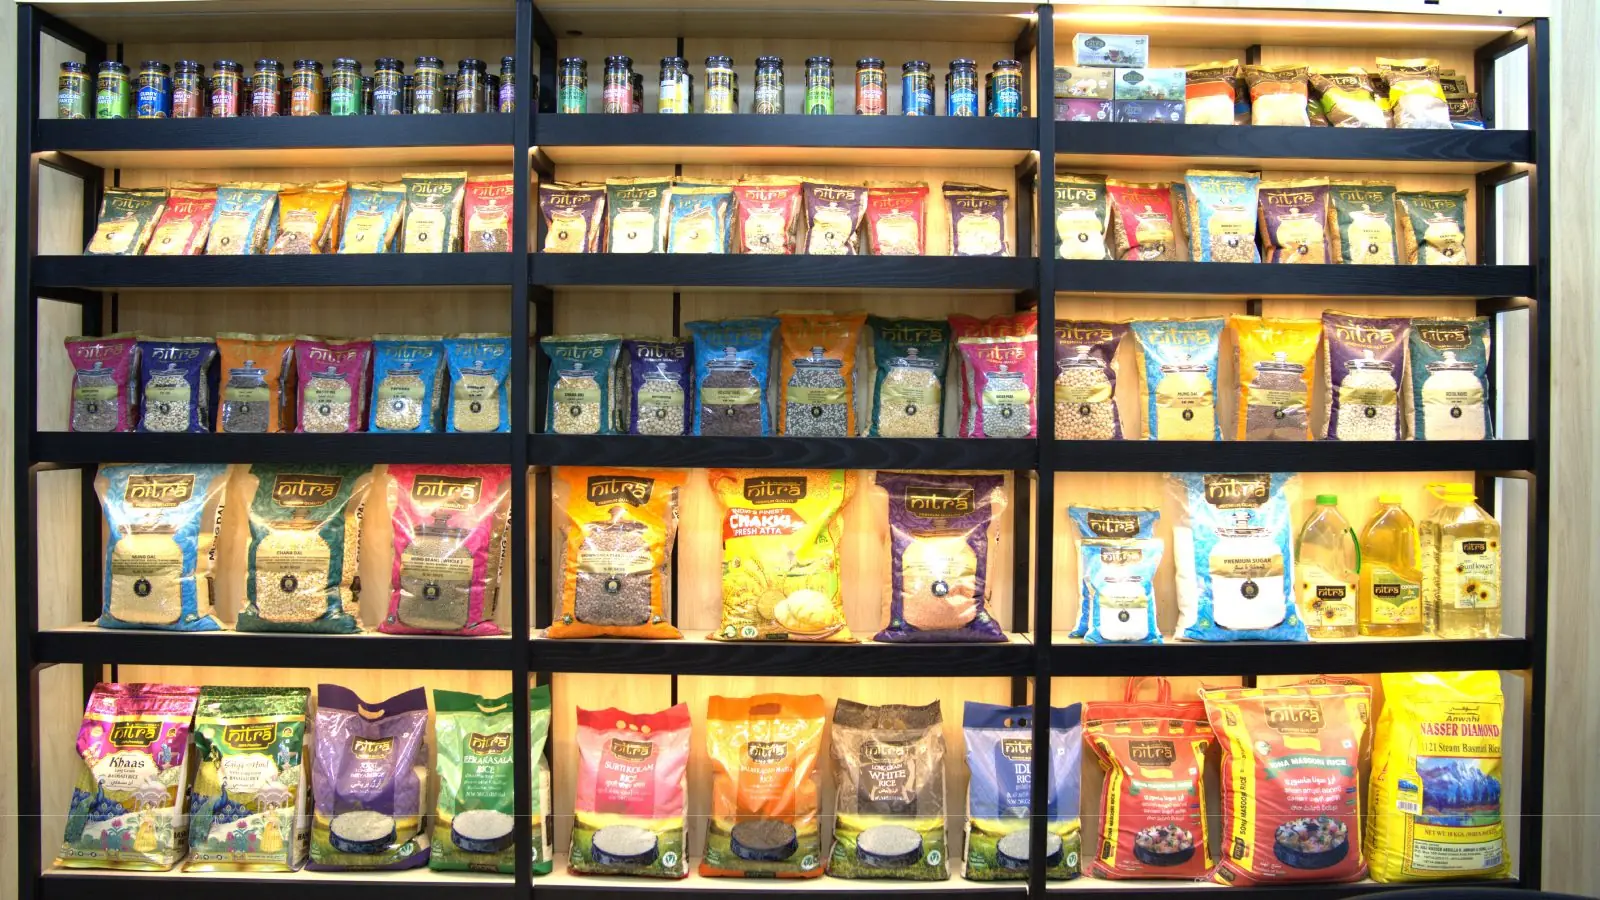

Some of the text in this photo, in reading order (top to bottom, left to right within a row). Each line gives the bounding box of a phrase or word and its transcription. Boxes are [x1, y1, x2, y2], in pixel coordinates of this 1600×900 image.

[411, 179, 452, 196] nitra
[473, 181, 514, 197] nitra
[617, 186, 657, 200] nitra
[745, 186, 787, 200] nitra
[813, 185, 856, 200] nitra
[1340, 187, 1384, 202] nitra
[1267, 189, 1315, 206] nitra
[882, 322, 944, 342] nitra
[1055, 323, 1113, 342] nitra
[1335, 319, 1396, 343] nitra
[1420, 327, 1466, 342] nitra
[152, 346, 201, 361] nitra
[310, 346, 357, 363] nitra
[555, 344, 604, 360] nitra
[637, 341, 685, 359] nitra
[977, 344, 1026, 361] nitra
[131, 479, 189, 499] nitra
[277, 479, 337, 497] nitra
[416, 479, 475, 500] nitra
[591, 478, 648, 500] nitra
[747, 480, 801, 498] nitra
[1208, 478, 1267, 498] nitra
[910, 493, 969, 511] nitra
[729, 513, 792, 530] CHAKKI
[1089, 517, 1136, 534] nitra
[734, 527, 782, 537] FRESH ATTA
[1318, 586, 1345, 598] nitra
[1375, 585, 1400, 596] nitra
[1269, 702, 1320, 723] nitra
[1445, 714, 1481, 723] Anwahi
[114, 722, 157, 740] nitra
[227, 724, 274, 743] nitra
[1420, 722, 1500, 738] NASSER DIAMOND
[612, 741, 650, 756] nitra
[1005, 739, 1032, 755] nitr
[1131, 742, 1173, 759] nitra
[1438, 741, 1461, 753] Steam
[1462, 742, 1488, 754] Basmati
[1488, 743, 1502, 754] Rice
[109, 756, 145, 769] Khaas
[475, 765, 496, 775] RICE
[604, 760, 627, 772] SURTI
[1014, 763, 1032, 774] IDL
[1326, 758, 1347, 767] RICE
[868, 769, 907, 780] WHITE
[877, 778, 897, 787] RICE
[1016, 774, 1032, 784] RIC
